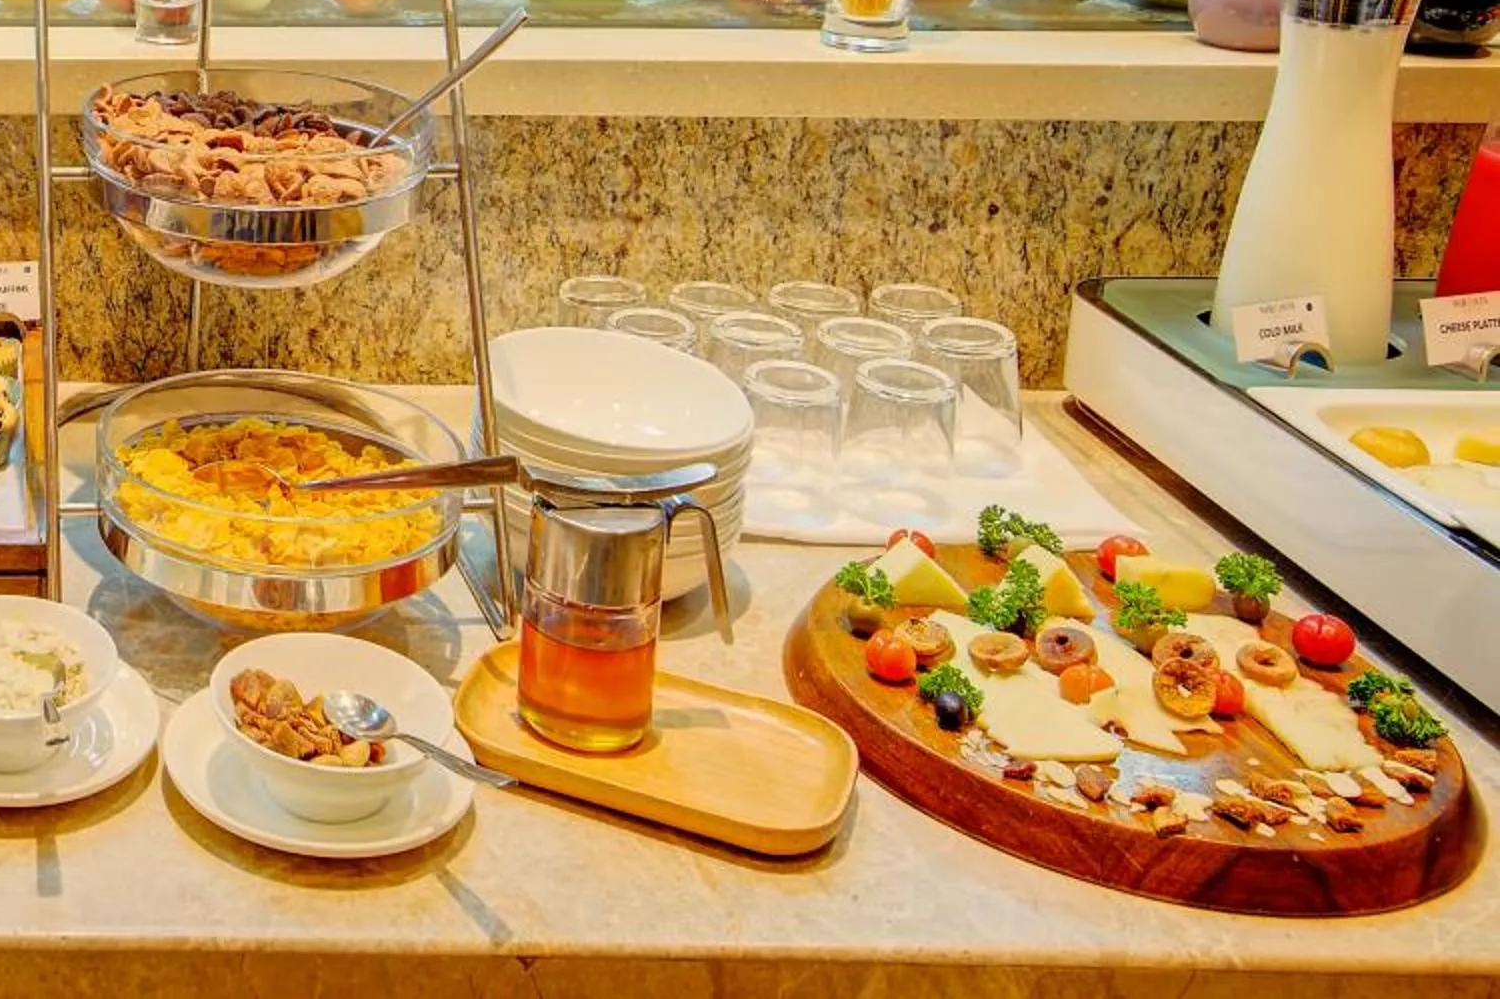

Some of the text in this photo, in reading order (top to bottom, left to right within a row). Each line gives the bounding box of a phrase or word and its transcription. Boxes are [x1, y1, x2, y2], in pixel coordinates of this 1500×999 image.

[1259, 322, 1305, 340] COLD MILK
[1440, 321, 1472, 334] CHEESE
